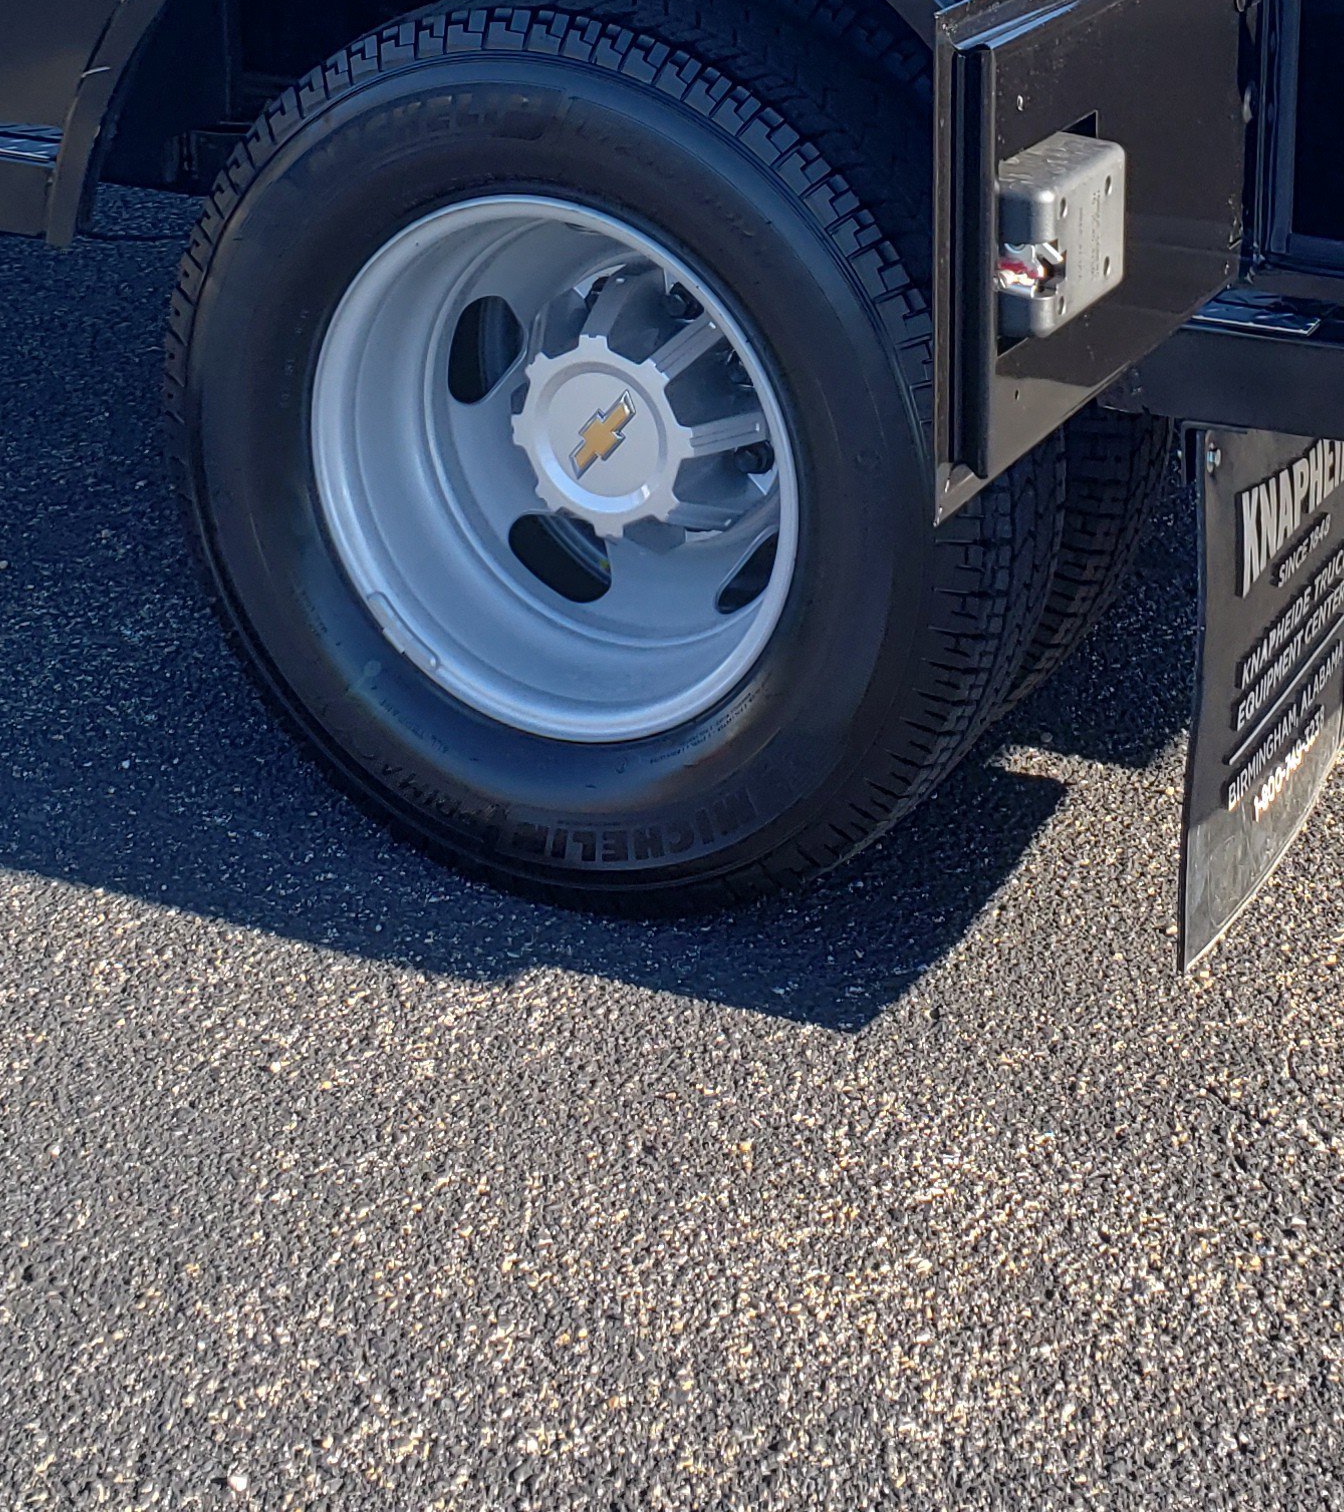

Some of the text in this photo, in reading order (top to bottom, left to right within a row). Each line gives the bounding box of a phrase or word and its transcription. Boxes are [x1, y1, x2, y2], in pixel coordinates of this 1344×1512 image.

[1277, 537, 1309, 589] SINCE
[1236, 629, 1305, 732] EQUIPMENT
[1241, 586, 1313, 691] KNAPHEIDE
[1228, 640, 1344, 812] BIRMINGHAM, ALABAMA
[510, 785, 758, 864] MICHELIN
